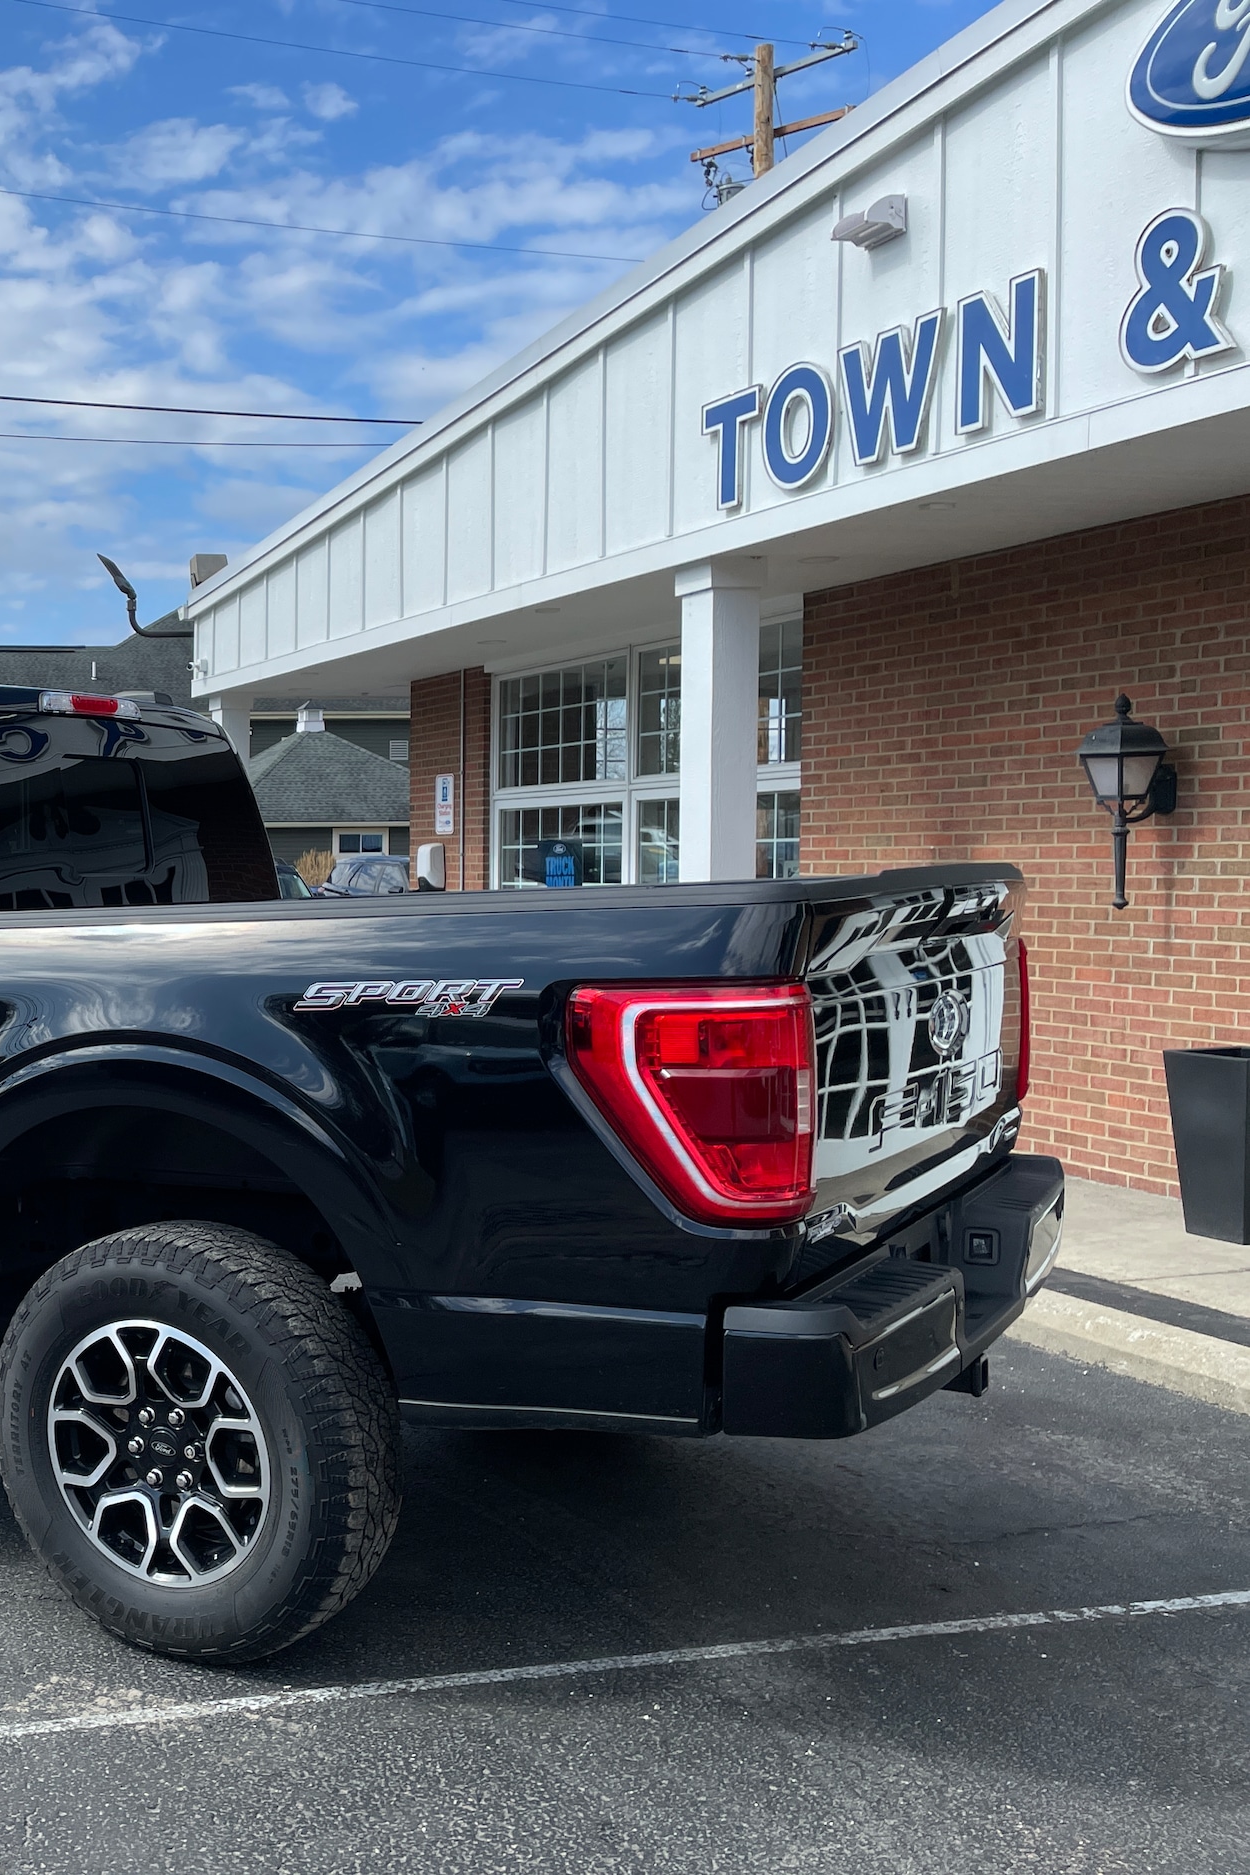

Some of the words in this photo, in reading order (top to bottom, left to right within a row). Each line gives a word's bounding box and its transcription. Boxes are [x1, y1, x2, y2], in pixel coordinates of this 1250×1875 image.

[701, 267, 1047, 510] TOWN
[1119, 206, 1238, 374] &
[545, 856, 574, 876] TRUCK
[293, 978, 524, 1011] SPORT
[10, 1378, 25, 1476] TERRITORY
